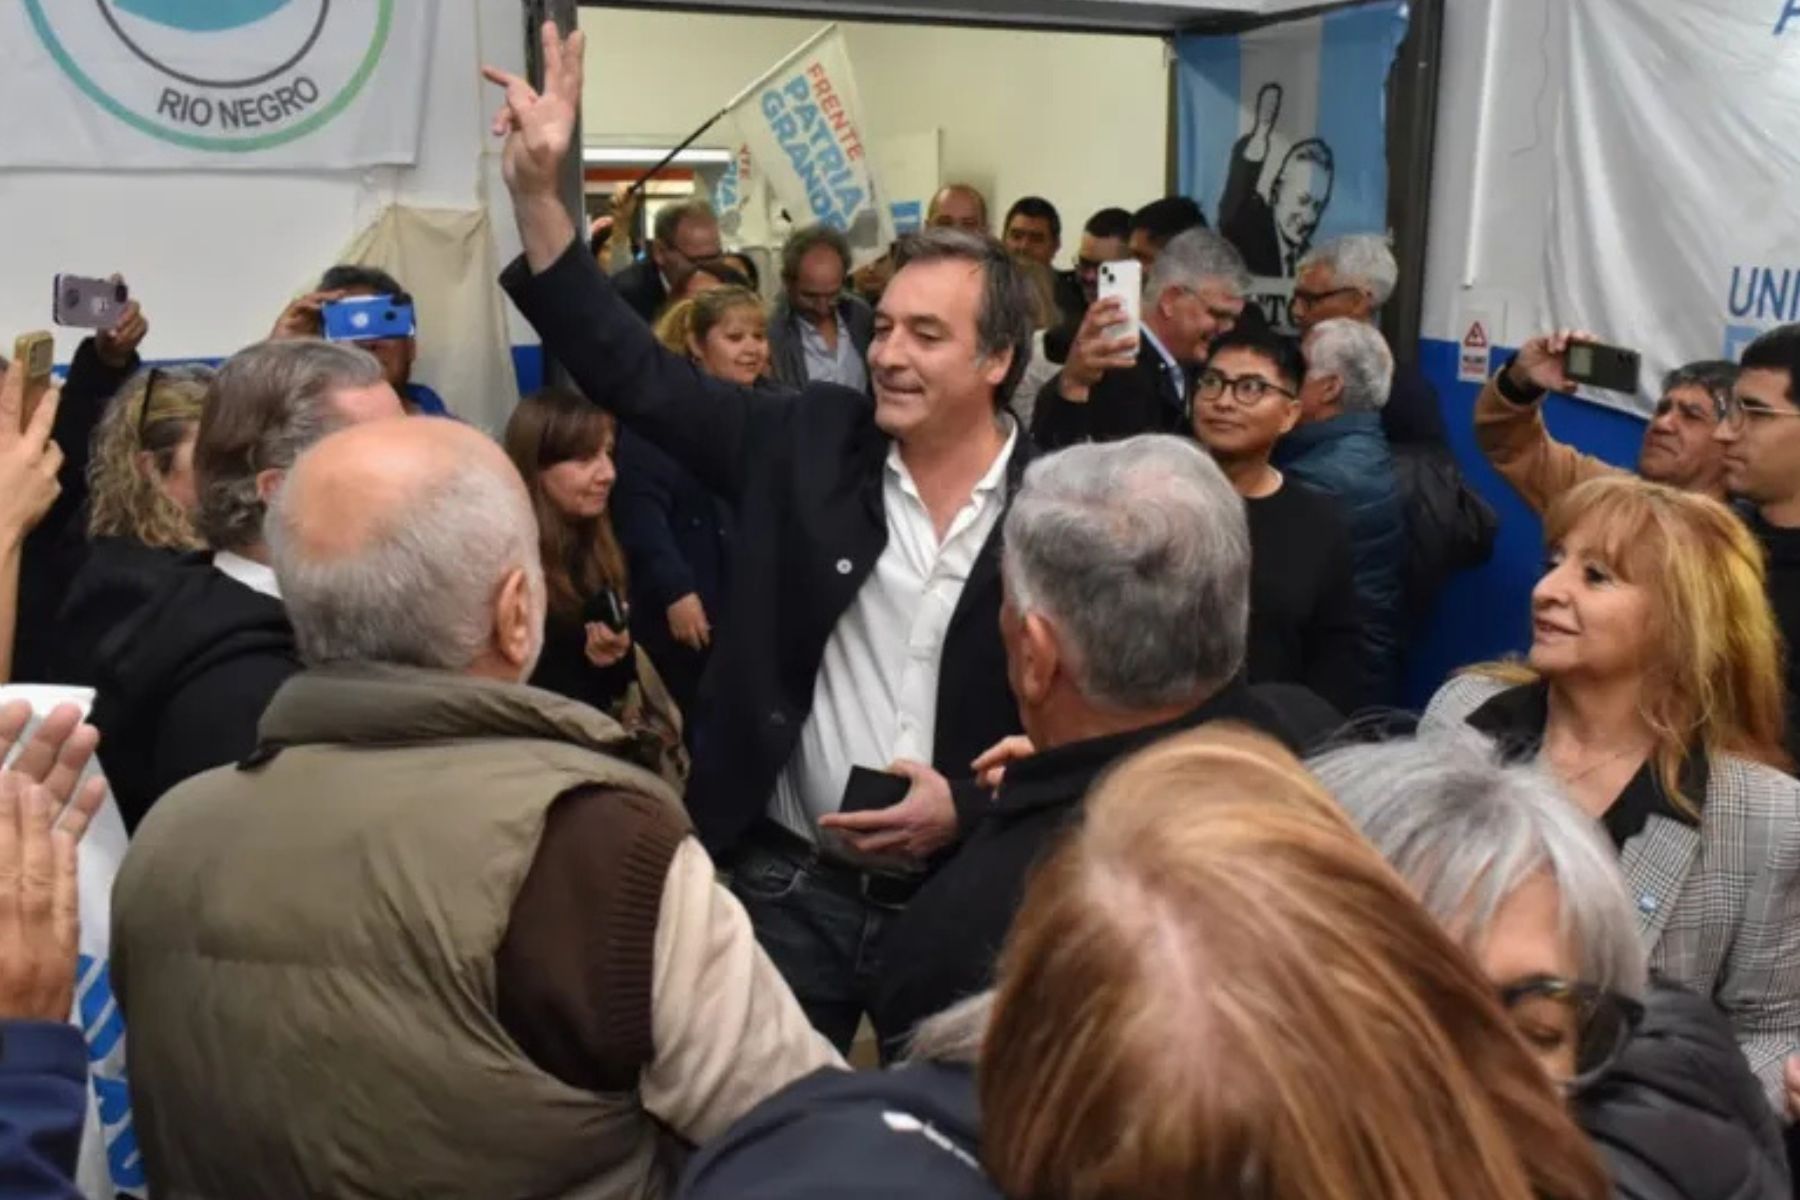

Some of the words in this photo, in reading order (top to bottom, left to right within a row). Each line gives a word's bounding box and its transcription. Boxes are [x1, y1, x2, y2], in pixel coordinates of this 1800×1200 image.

[156, 87, 213, 126] RIO
[218, 76, 318, 129] NEGRO
[783, 74, 864, 219] PATRIA
[806, 62, 866, 161] FRENTE
